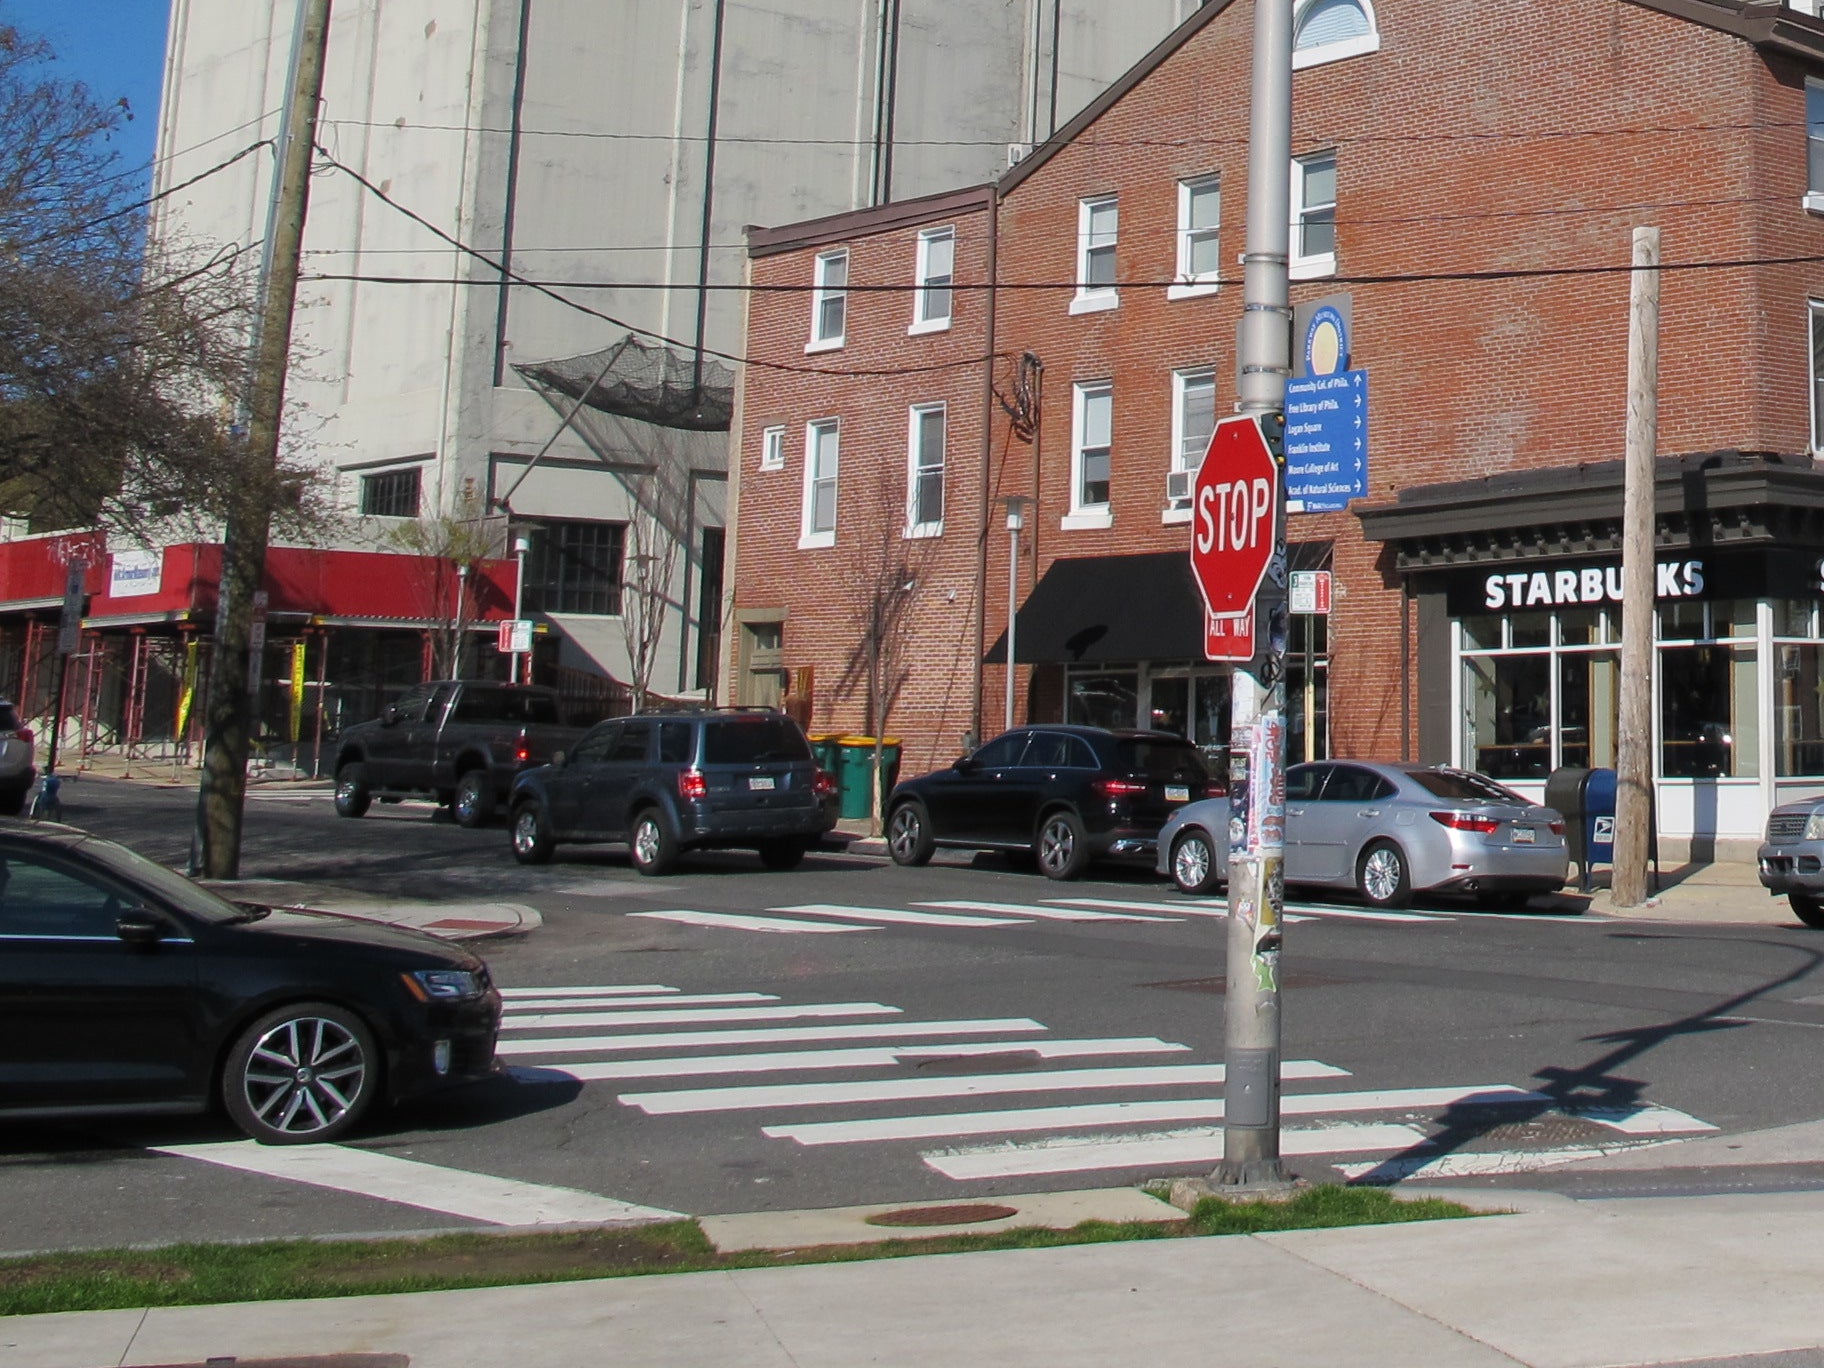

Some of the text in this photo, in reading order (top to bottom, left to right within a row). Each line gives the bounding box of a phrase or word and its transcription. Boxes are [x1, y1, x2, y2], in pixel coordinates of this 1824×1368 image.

[1197, 477, 1270, 555] STOP
[1485, 561, 1705, 609] STARBUKS
[1209, 615, 1251, 637] ALL WAY
